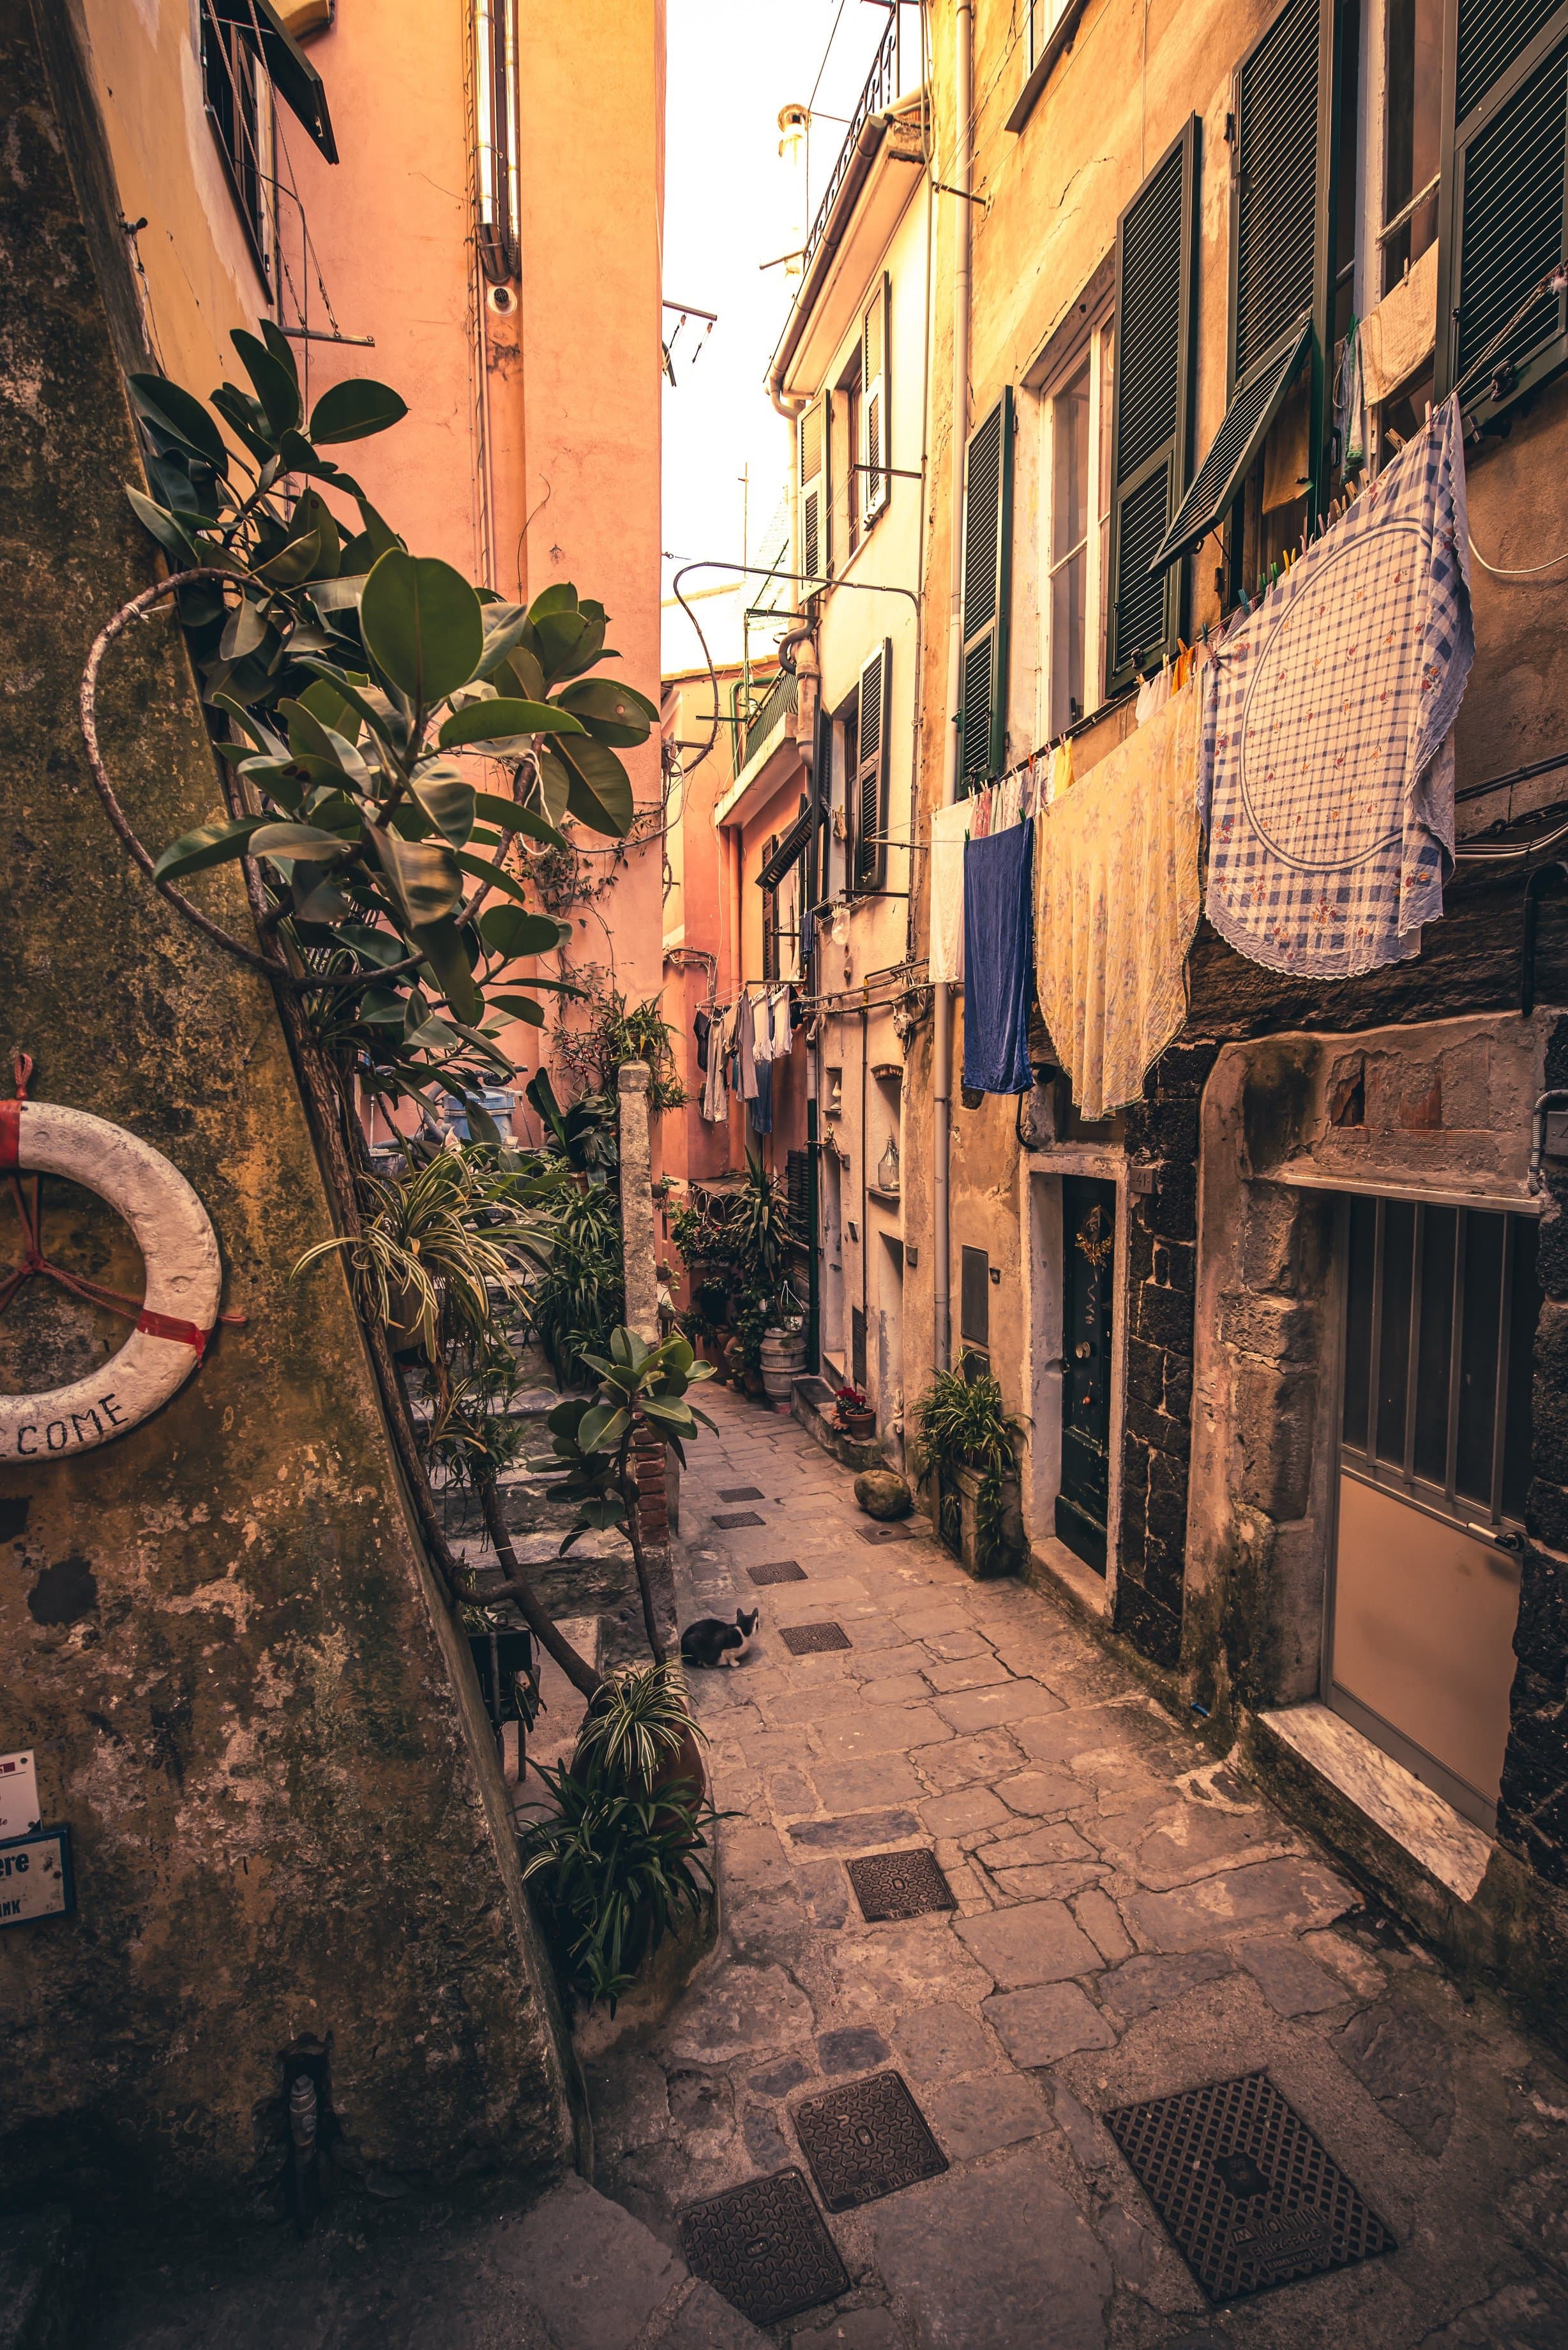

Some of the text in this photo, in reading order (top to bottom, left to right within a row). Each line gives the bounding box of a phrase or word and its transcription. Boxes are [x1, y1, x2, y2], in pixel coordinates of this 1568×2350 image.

[1132, 1172, 1147, 1187] 41
[0, 1393, 128, 1457] COME
[856, 2167, 920, 2200] ACAM GAS
